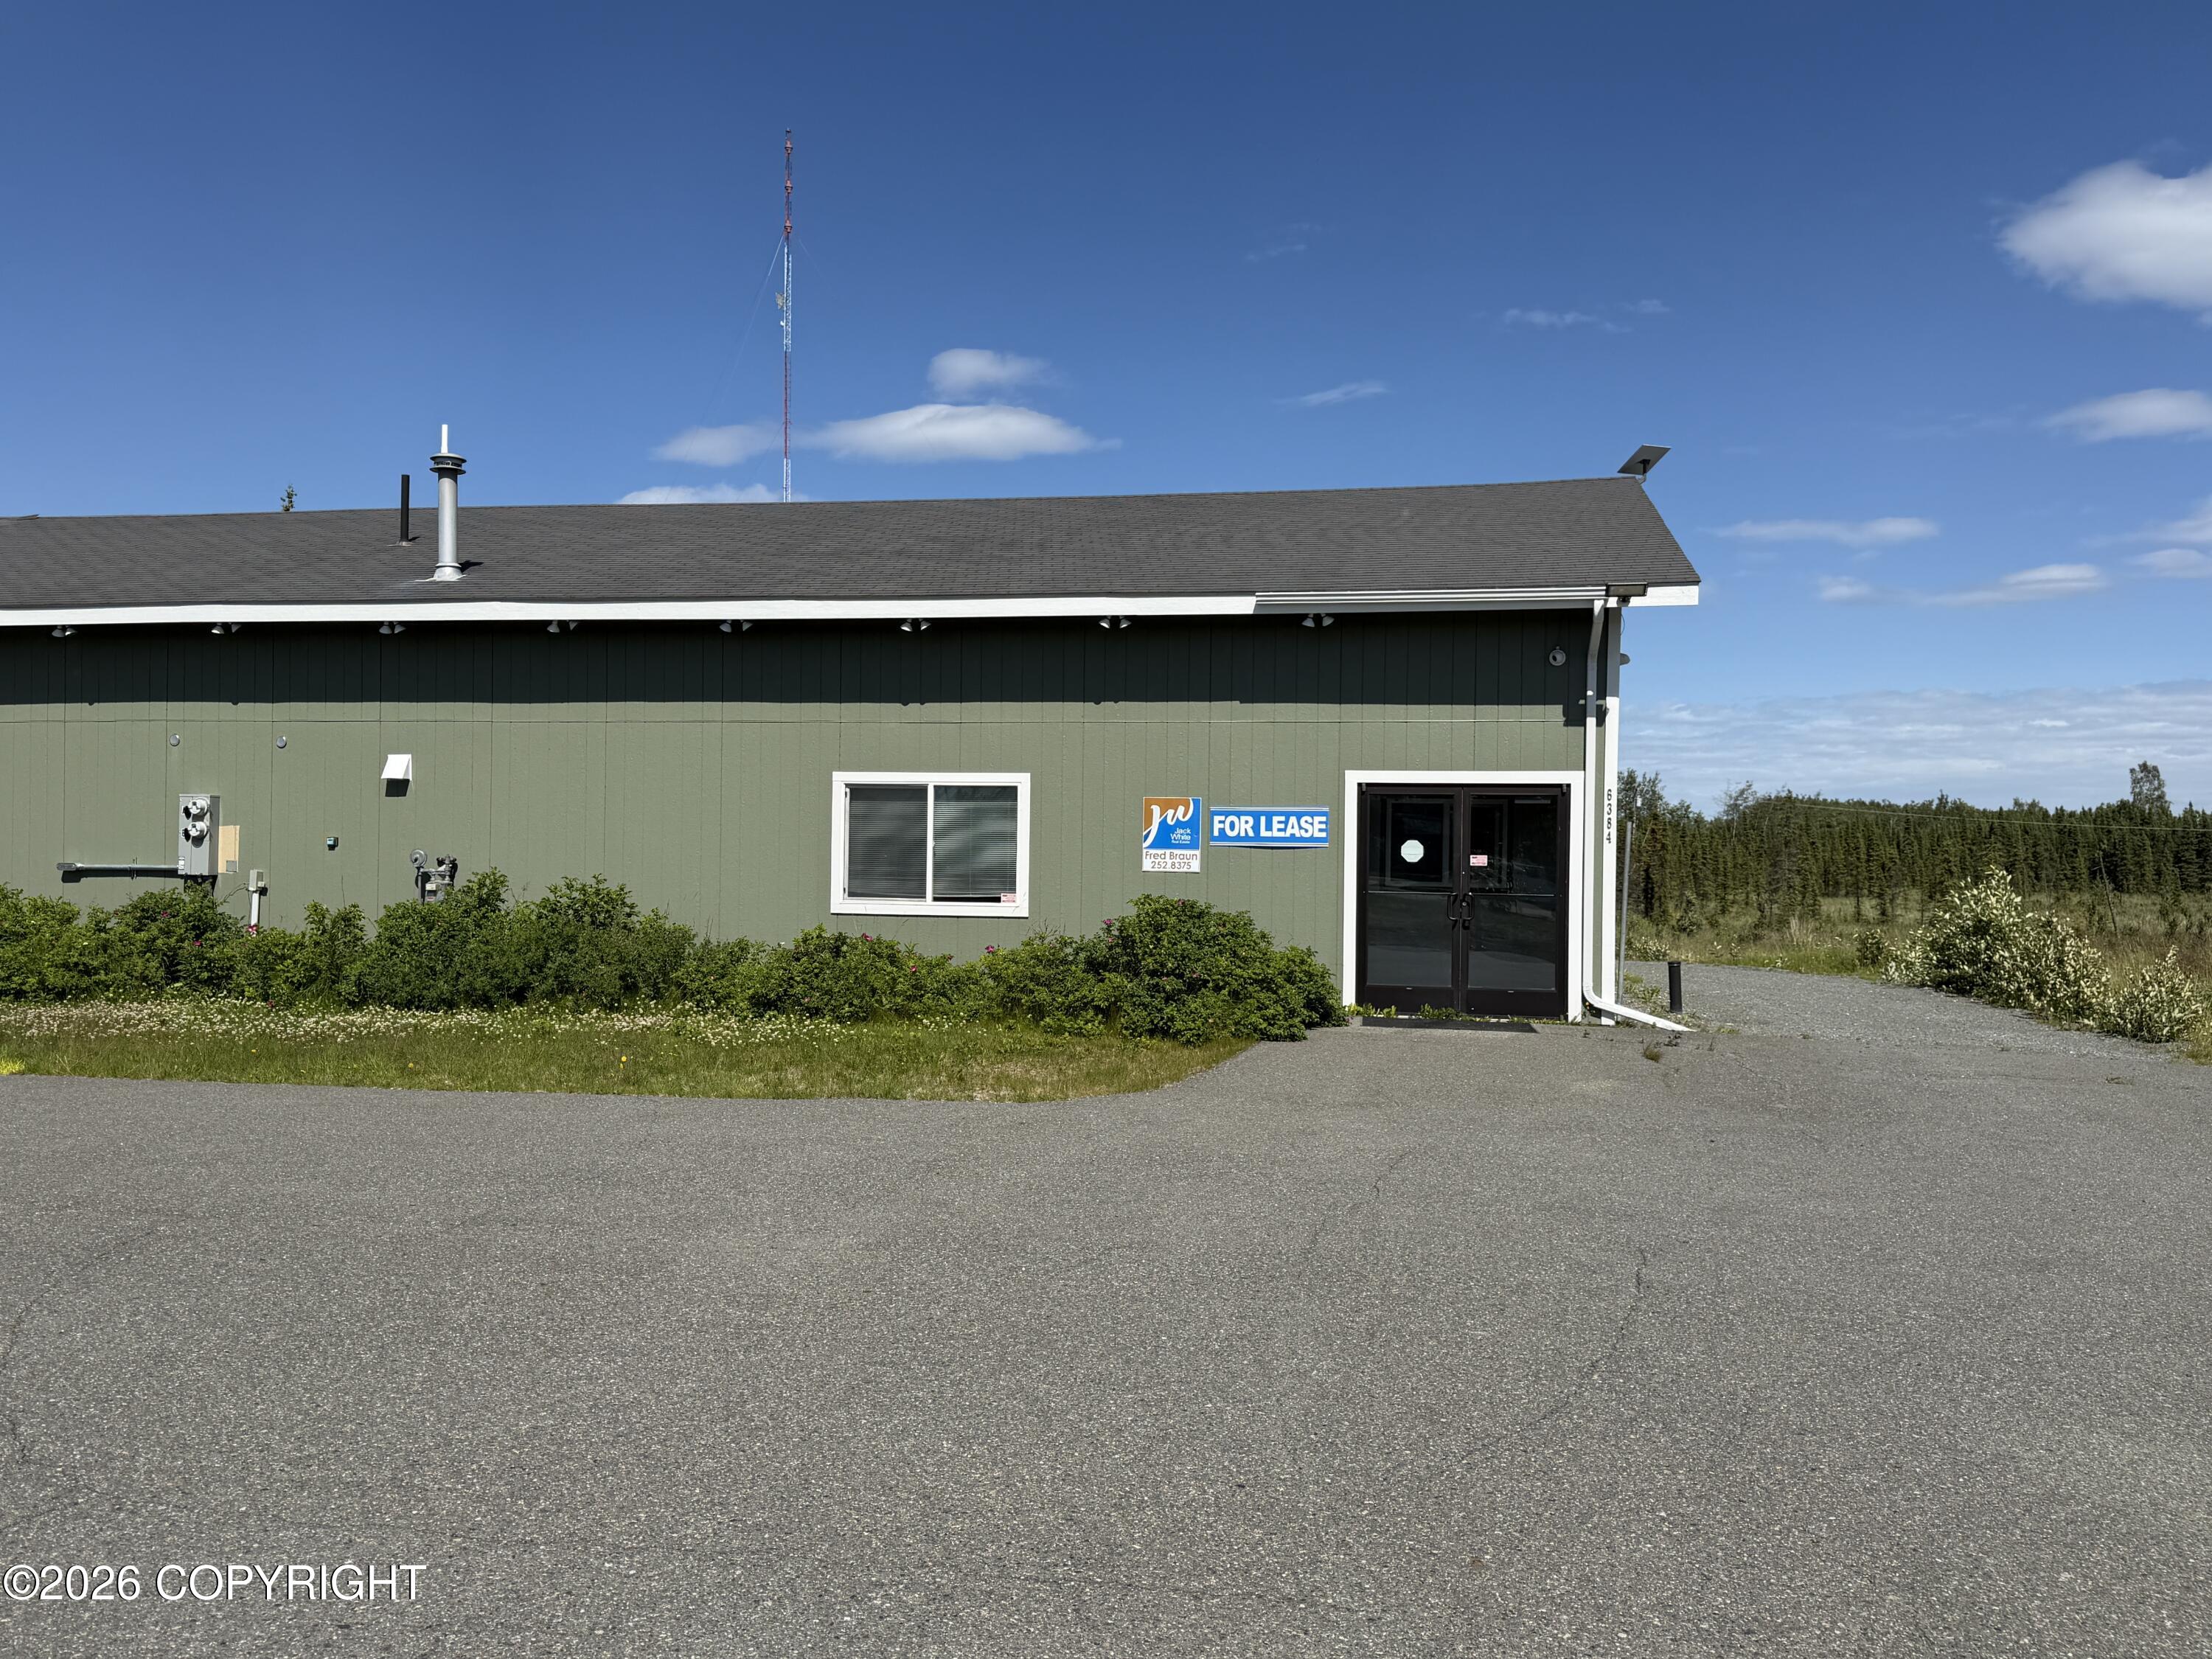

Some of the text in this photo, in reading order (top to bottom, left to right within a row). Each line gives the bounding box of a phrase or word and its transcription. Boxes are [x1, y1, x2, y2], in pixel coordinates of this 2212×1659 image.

[1213, 815, 1327, 838] FOR LEASE
[1145, 851, 1197, 860] Fred Braun
[1150, 860, 1192, 869] 252.8375
